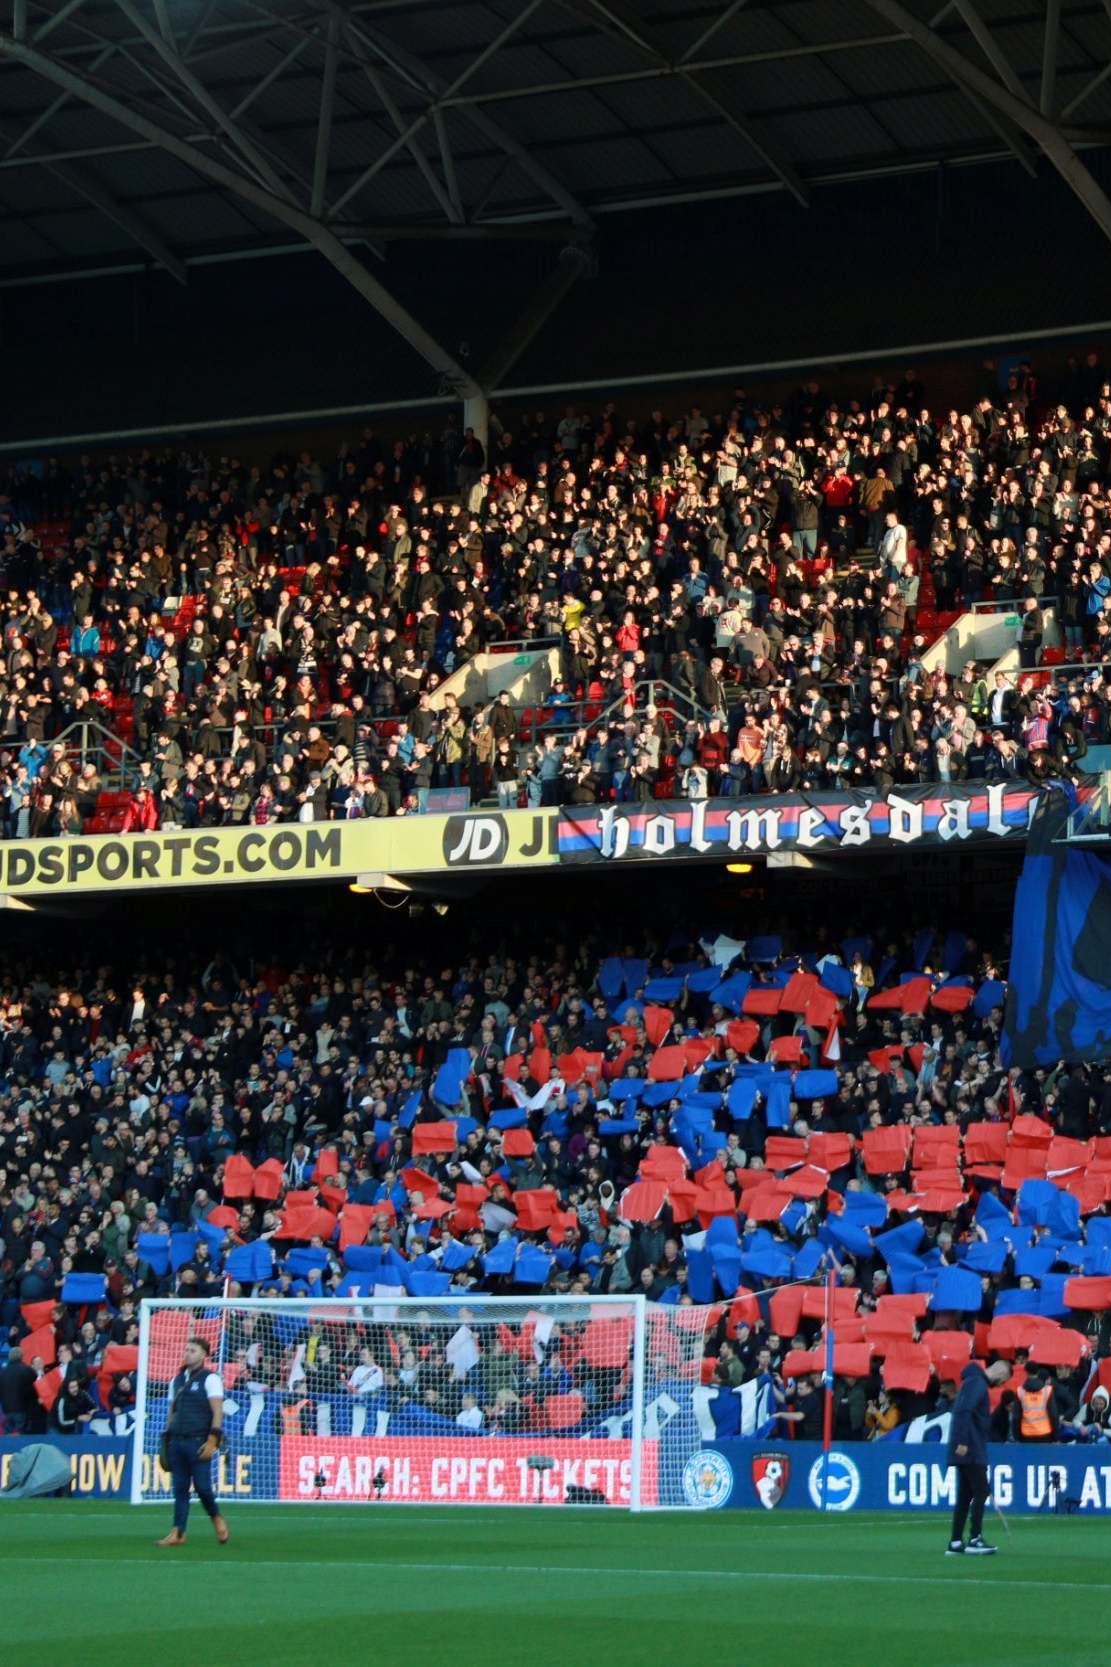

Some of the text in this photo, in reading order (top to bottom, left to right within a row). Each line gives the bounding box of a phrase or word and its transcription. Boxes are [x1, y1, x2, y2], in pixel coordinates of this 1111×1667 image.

[449, 818, 501, 861] JD
[518, 815, 558, 857] J
[599, 783, 1039, 858] holmesdal
[0, 828, 341, 886] DSPORTS.COM
[299, 1456, 419, 1497] SEARCH:
[431, 1457, 505, 1498] CPFC
[888, 1463, 1013, 1507] COMG
[1027, 1465, 1067, 1508] UP
